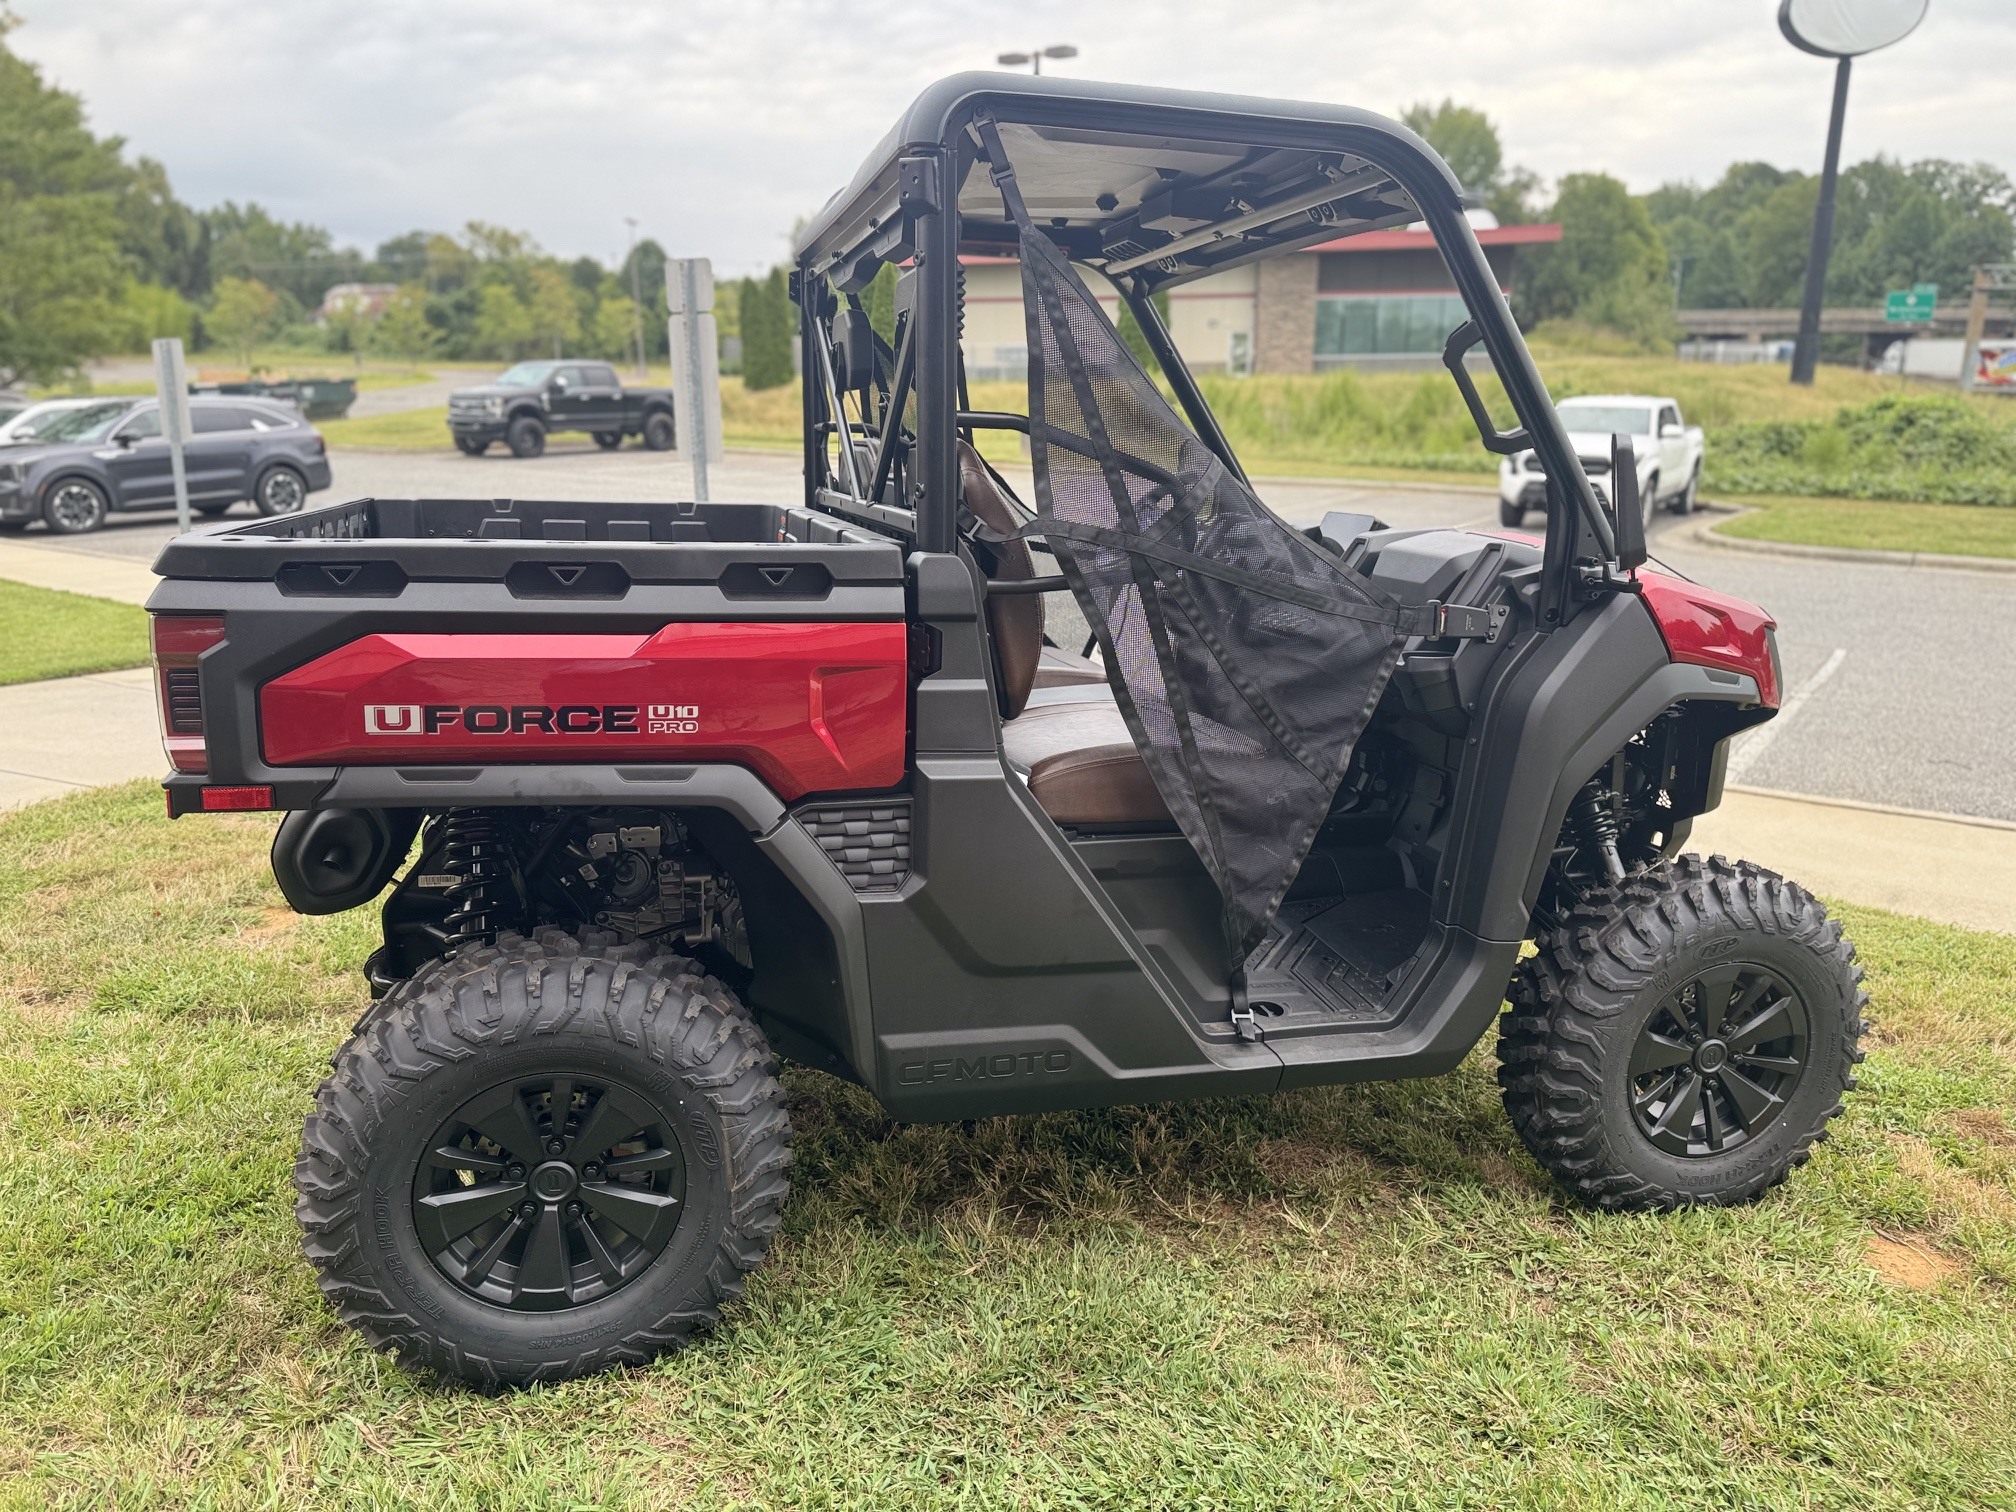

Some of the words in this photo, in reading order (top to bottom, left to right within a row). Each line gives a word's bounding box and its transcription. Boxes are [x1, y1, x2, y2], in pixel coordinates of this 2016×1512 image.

[648, 705, 699, 719] U10
[648, 720, 699, 734] PRO
[1700, 937, 1738, 958] ITP
[898, 1050, 1071, 1086] CFMOTO
[691, 1118, 720, 1163] ITP
[374, 1184, 395, 1250] HOOK
[385, 1252, 445, 1320] TERRA
